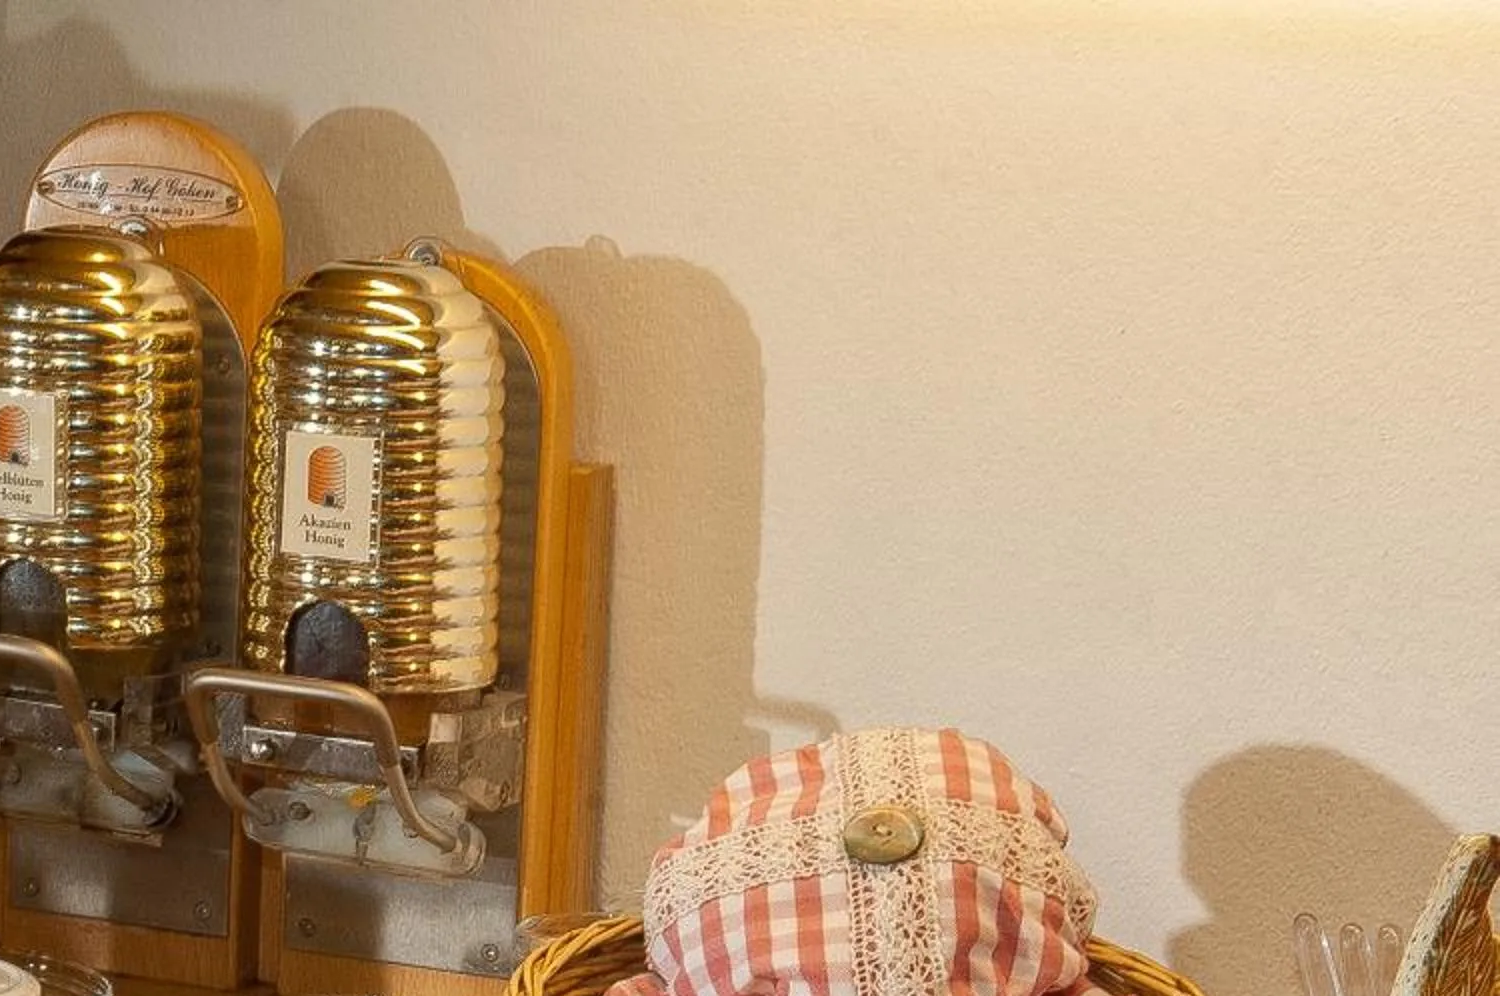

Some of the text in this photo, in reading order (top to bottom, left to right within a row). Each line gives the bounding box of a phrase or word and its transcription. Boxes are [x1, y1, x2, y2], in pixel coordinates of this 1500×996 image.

[57, 172, 109, 197] Honig
[299, 512, 352, 531] Akazien
[304, 530, 346, 549] Honig
